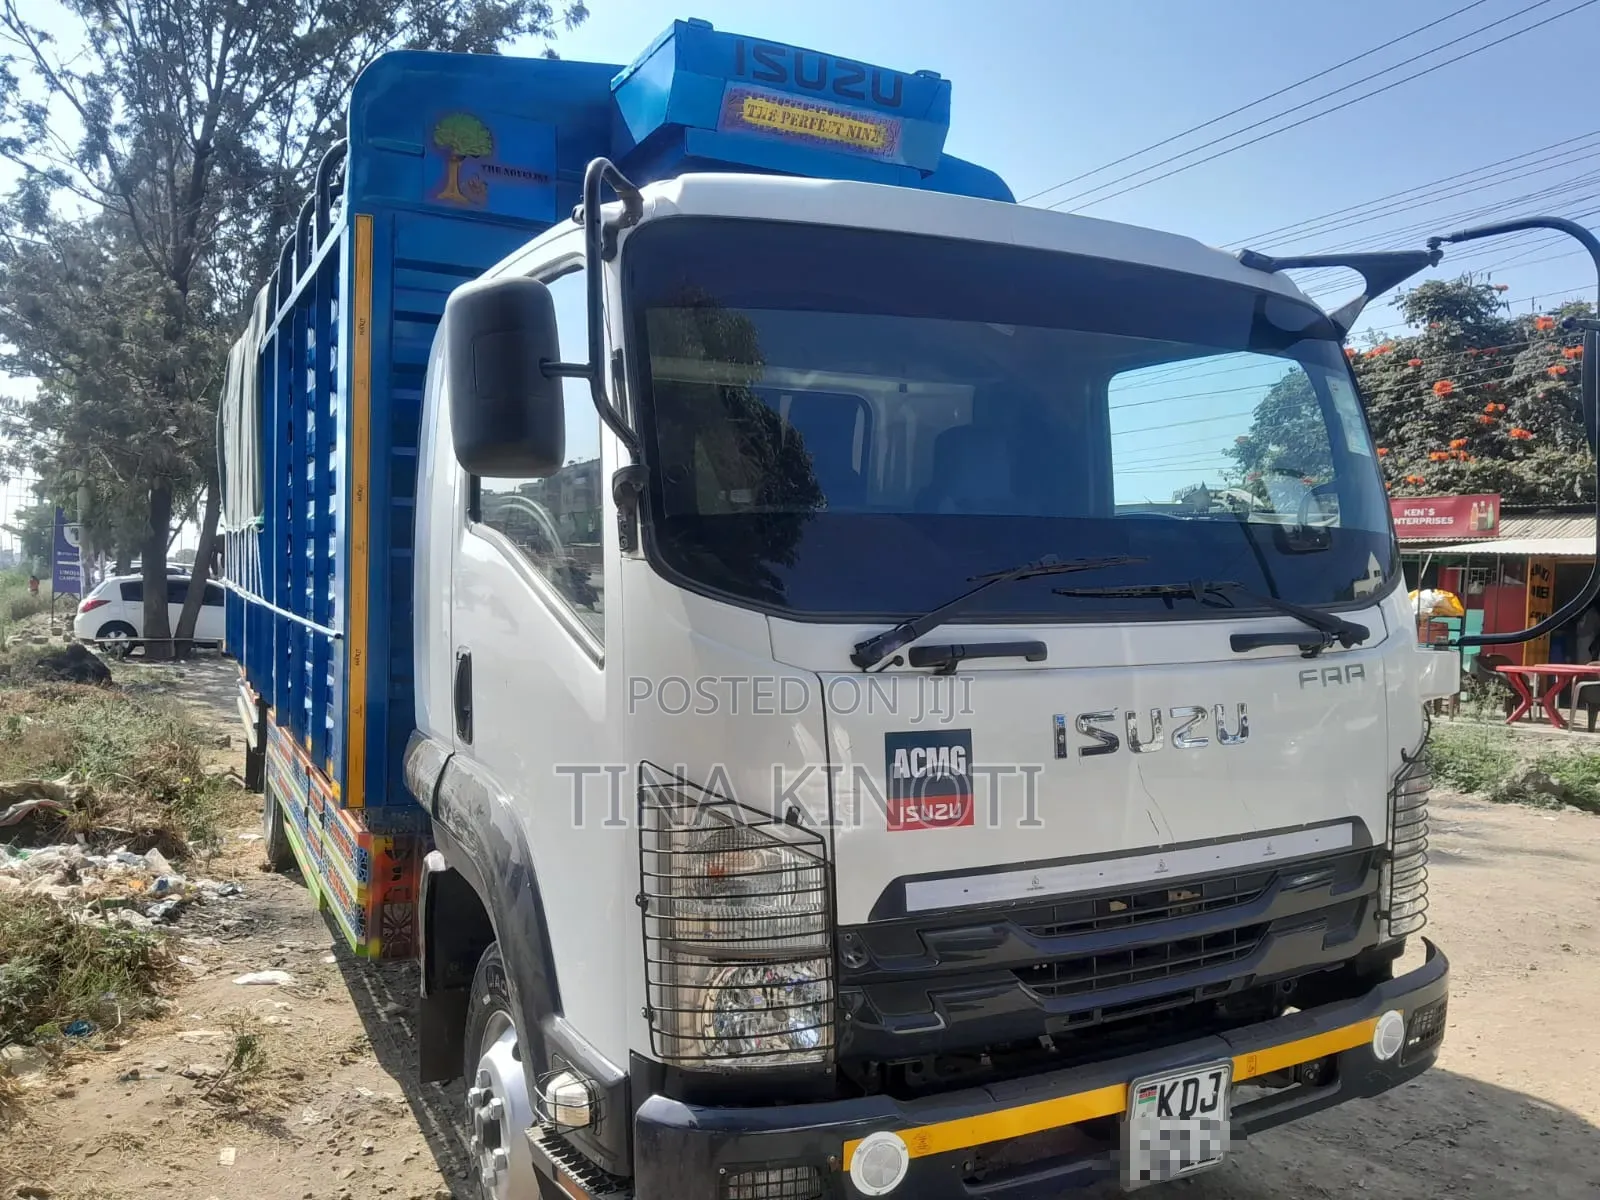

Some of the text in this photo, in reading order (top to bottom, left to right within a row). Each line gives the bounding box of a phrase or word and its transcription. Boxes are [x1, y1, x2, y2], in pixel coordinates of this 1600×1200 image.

[735, 39, 902, 108] ISUZU
[747, 103, 777, 122] THE
[780, 111, 844, 136] PERFECT
[481, 164, 501, 174] THE
[1393, 517, 1454, 525] NTERPRISES
[1052, 702, 1249, 760] ISUZU
[893, 745, 967, 782] ACMG
[900, 803, 962, 823] ISUZU
[1157, 1071, 1222, 1120] KDJ
